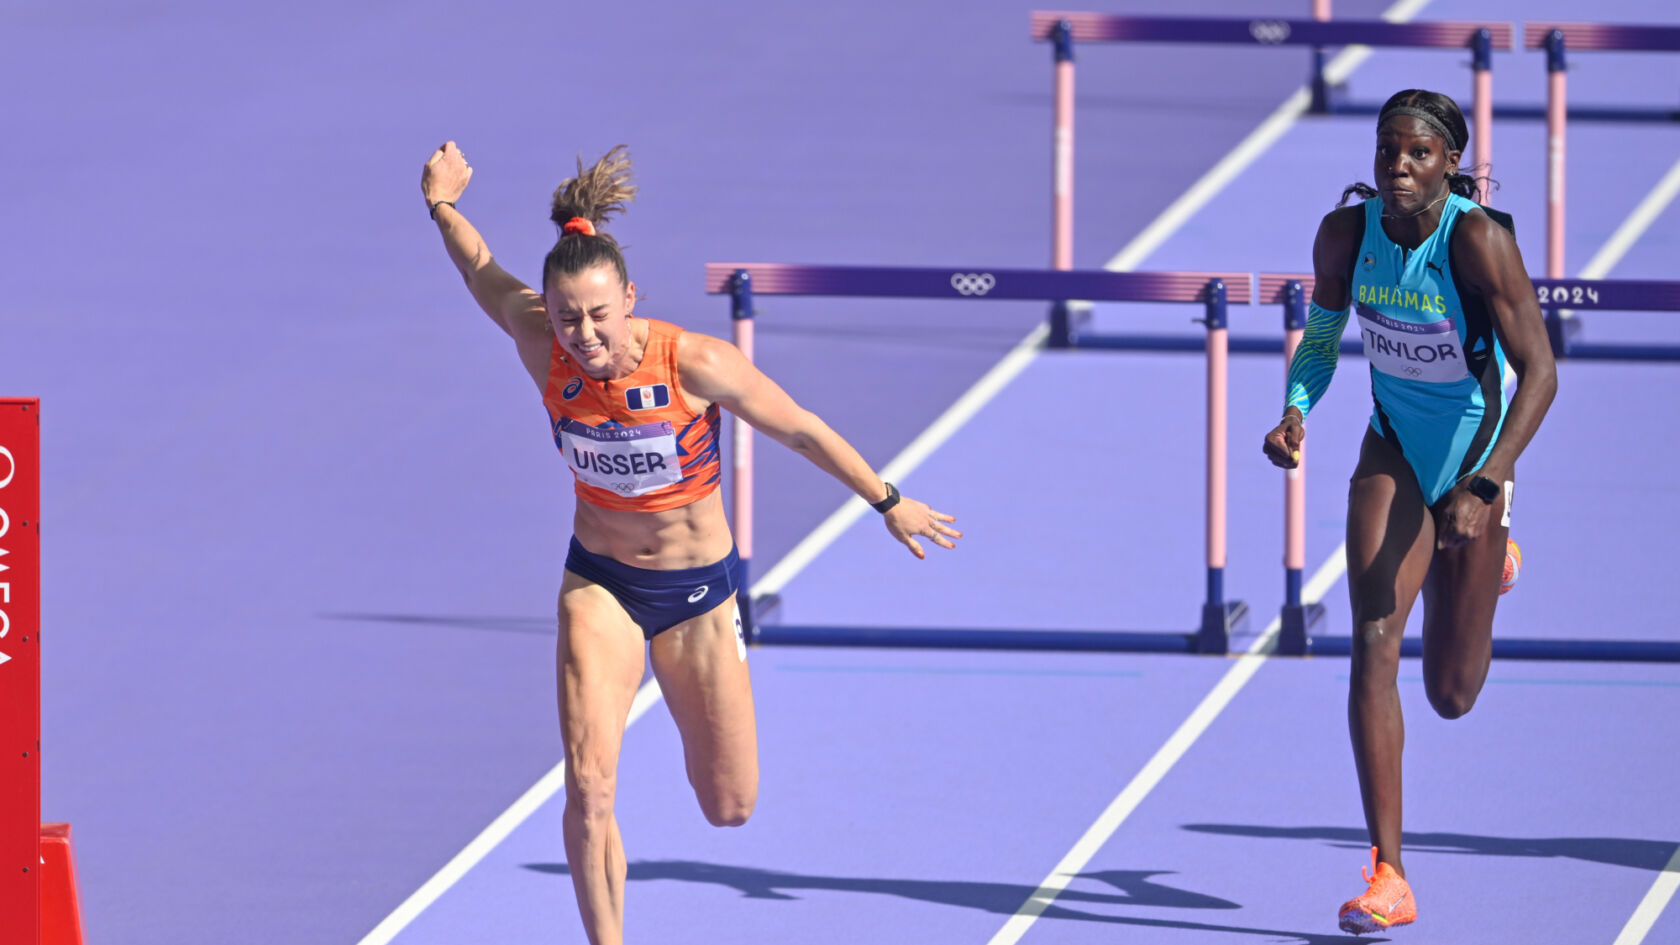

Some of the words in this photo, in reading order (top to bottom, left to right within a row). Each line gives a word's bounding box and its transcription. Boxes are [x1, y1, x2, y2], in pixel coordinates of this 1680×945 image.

[1359, 285, 1447, 314] BAHAMAS
[1537, 286, 1599, 304] 2024
[1365, 327, 1457, 363] TAYLOR
[586, 427, 611, 439] PARIS
[614, 428, 641, 439] 2024
